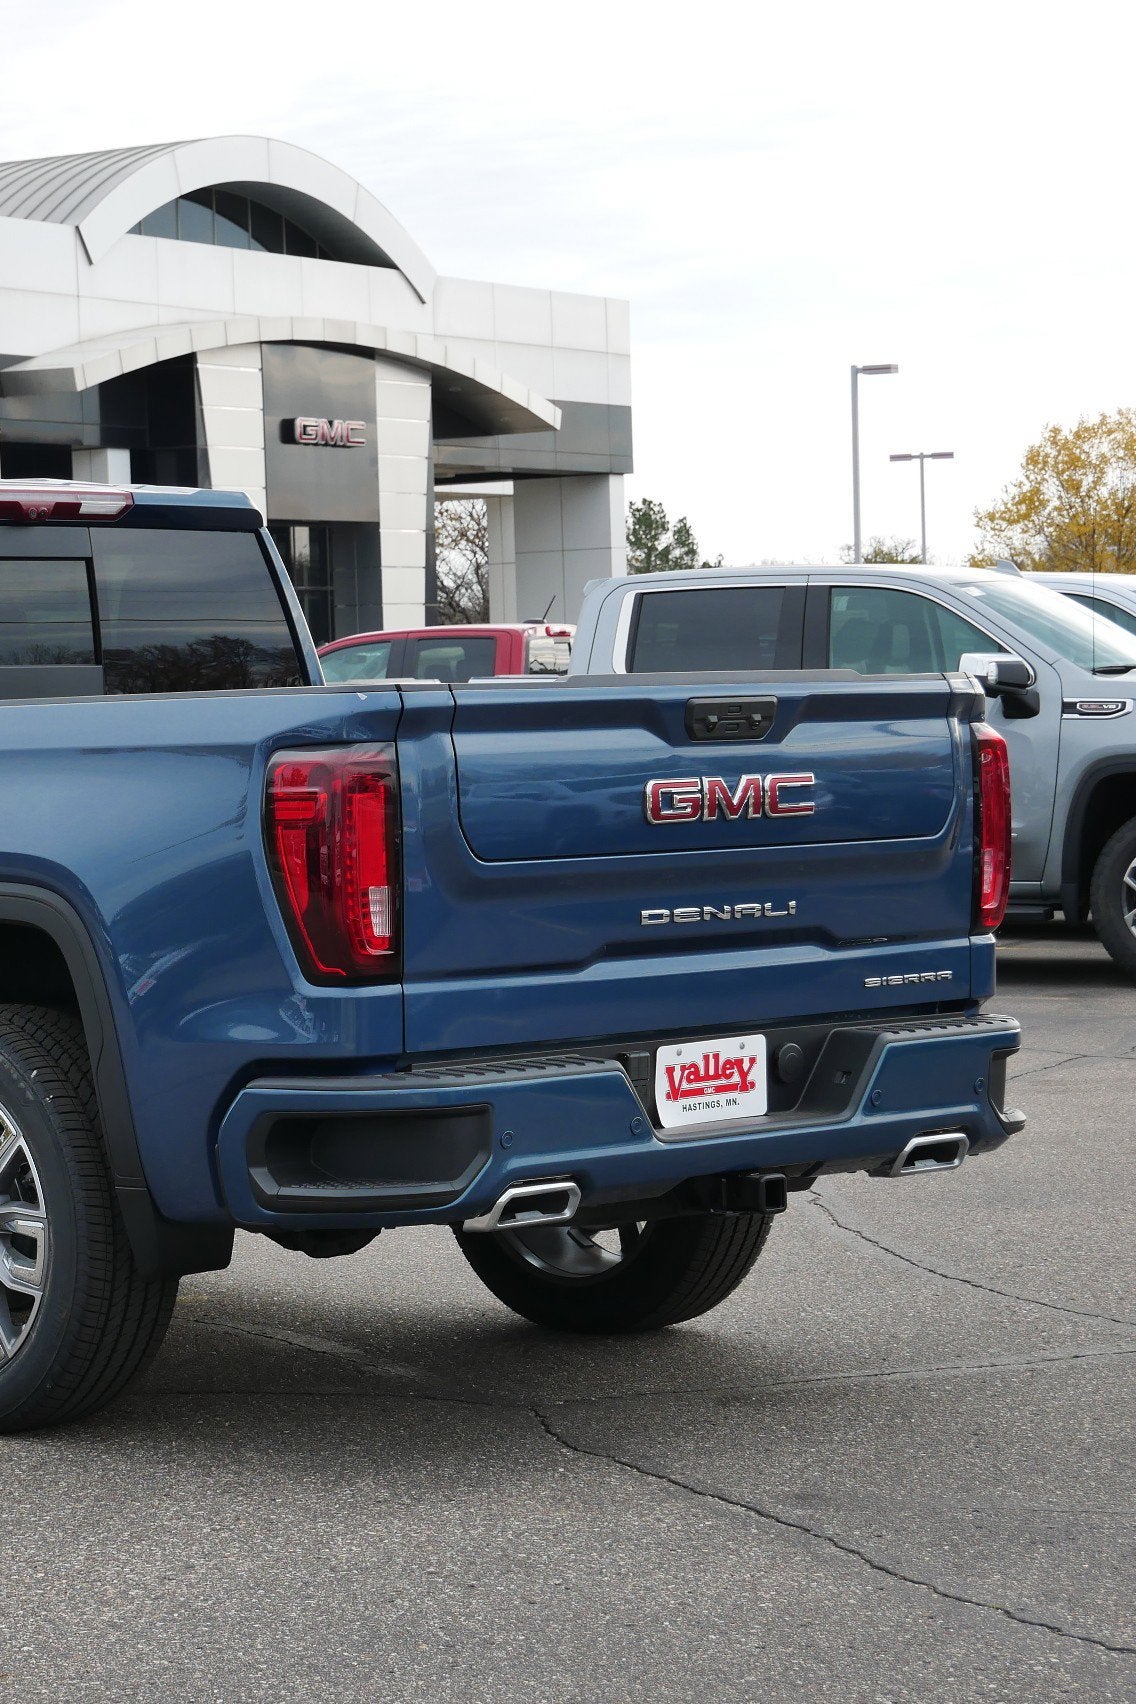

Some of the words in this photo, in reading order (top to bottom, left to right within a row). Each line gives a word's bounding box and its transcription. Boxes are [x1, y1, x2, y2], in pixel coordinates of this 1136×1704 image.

[294, 416, 367, 447] GMC
[644, 771, 815, 825] GMC
[640, 900, 796, 926] DENALI
[864, 970, 953, 988] SIERRA
[664, 1051, 758, 1102] Valley
[682, 1099, 724, 1113] HASTINGS,
[725, 1098, 740, 1107] MN.
